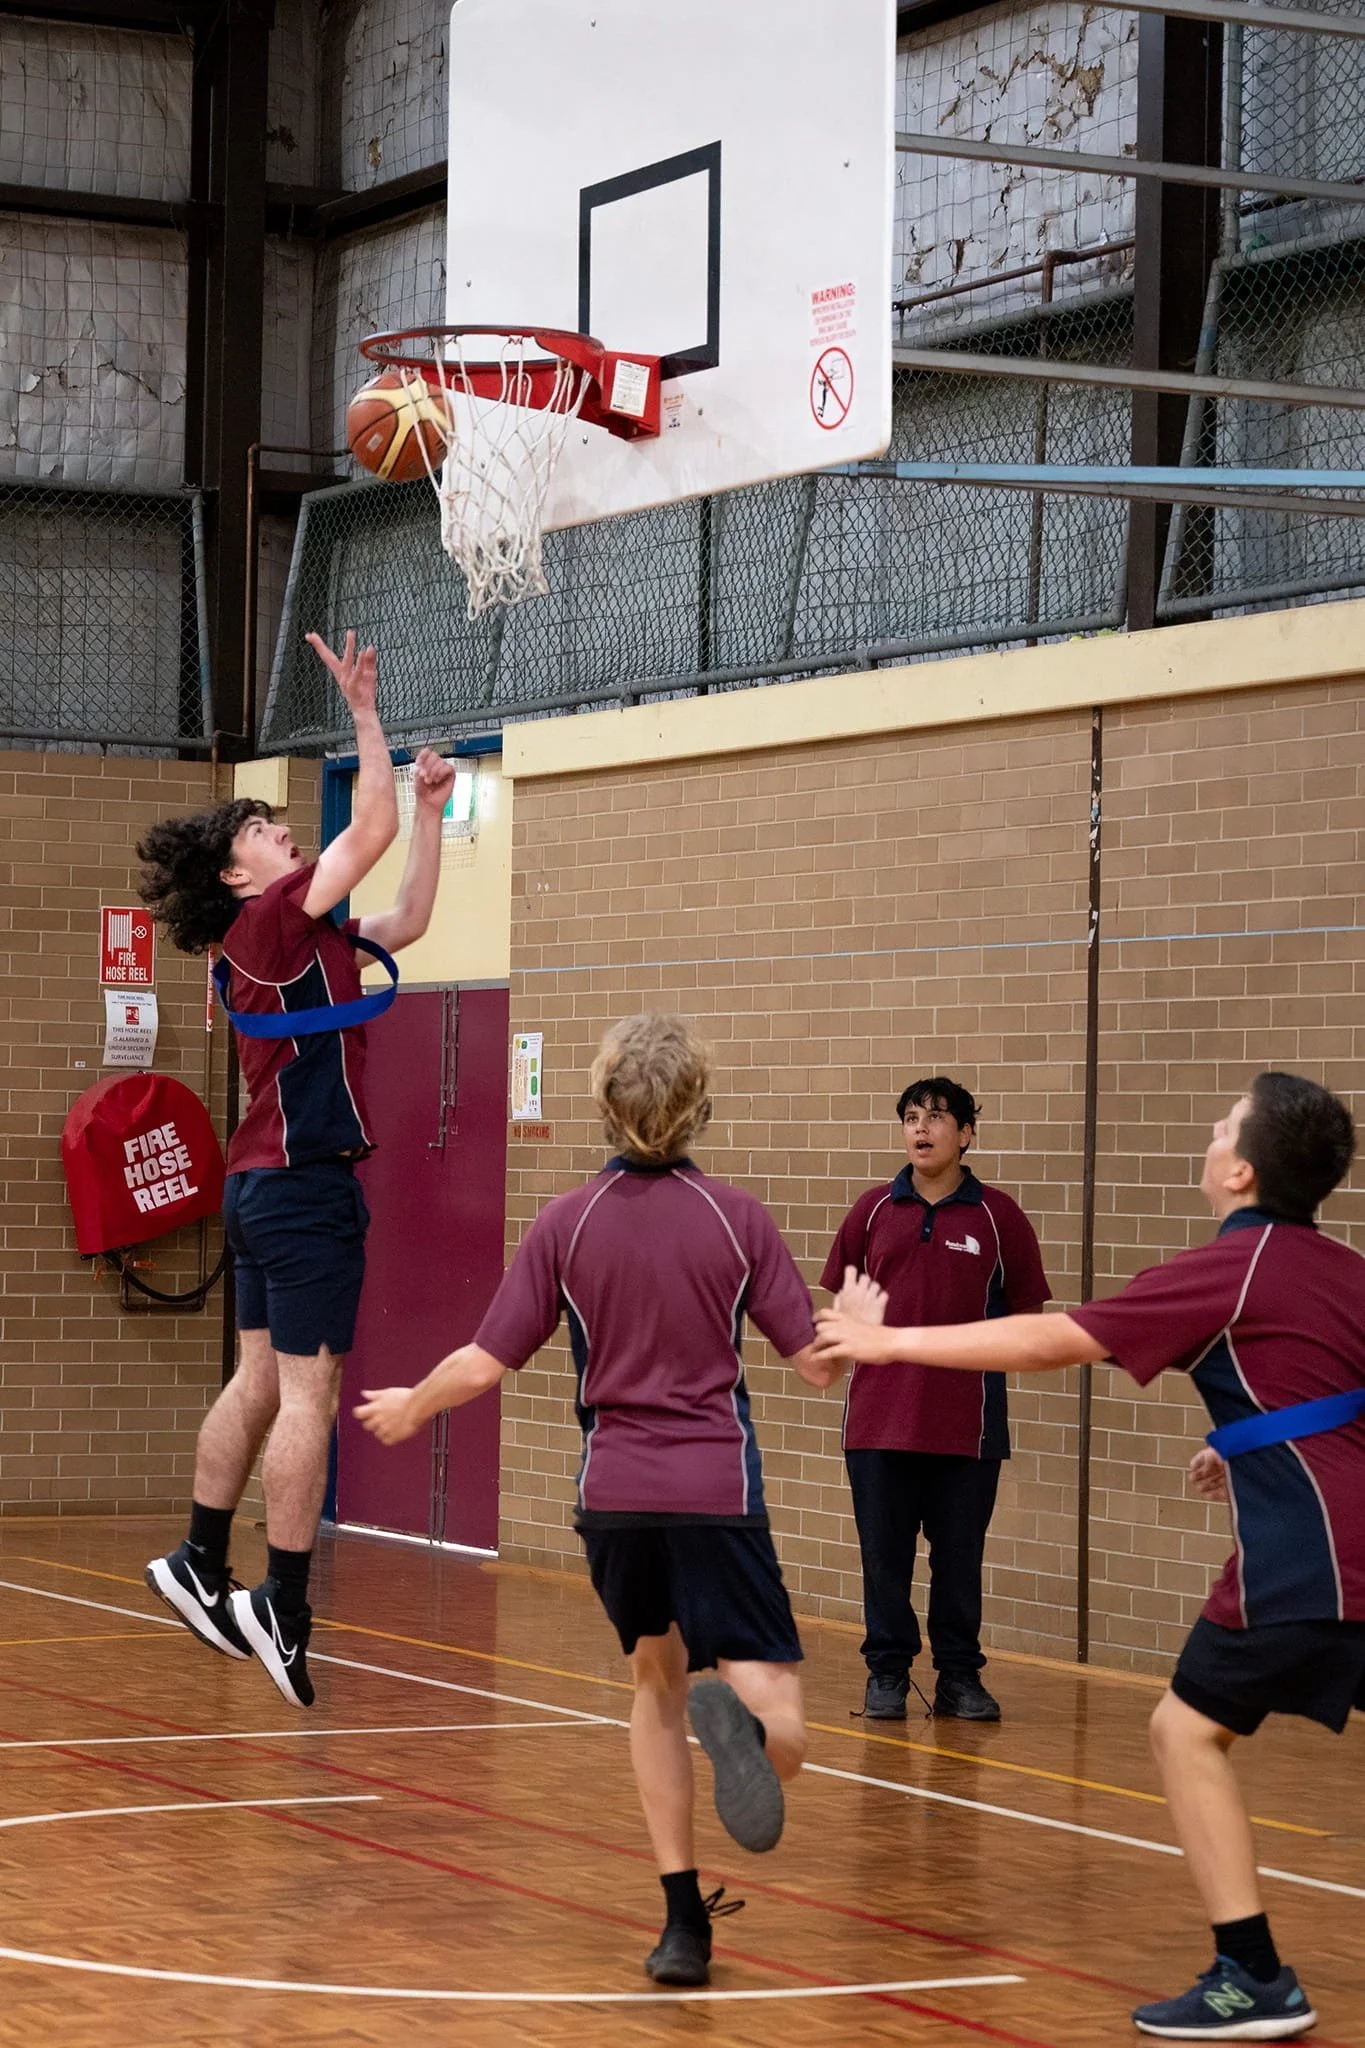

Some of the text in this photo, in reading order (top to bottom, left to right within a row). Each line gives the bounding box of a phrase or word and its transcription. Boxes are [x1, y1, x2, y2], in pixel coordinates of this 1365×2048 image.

[811, 282, 856, 304] WARNING:
[105, 966, 149, 981] HOSE REEL
[118, 951, 137, 966] FIRE
[124, 1122, 180, 1163] FIRE
[124, 1144, 193, 1189] HOSE
[132, 1173, 199, 1213] REEL
